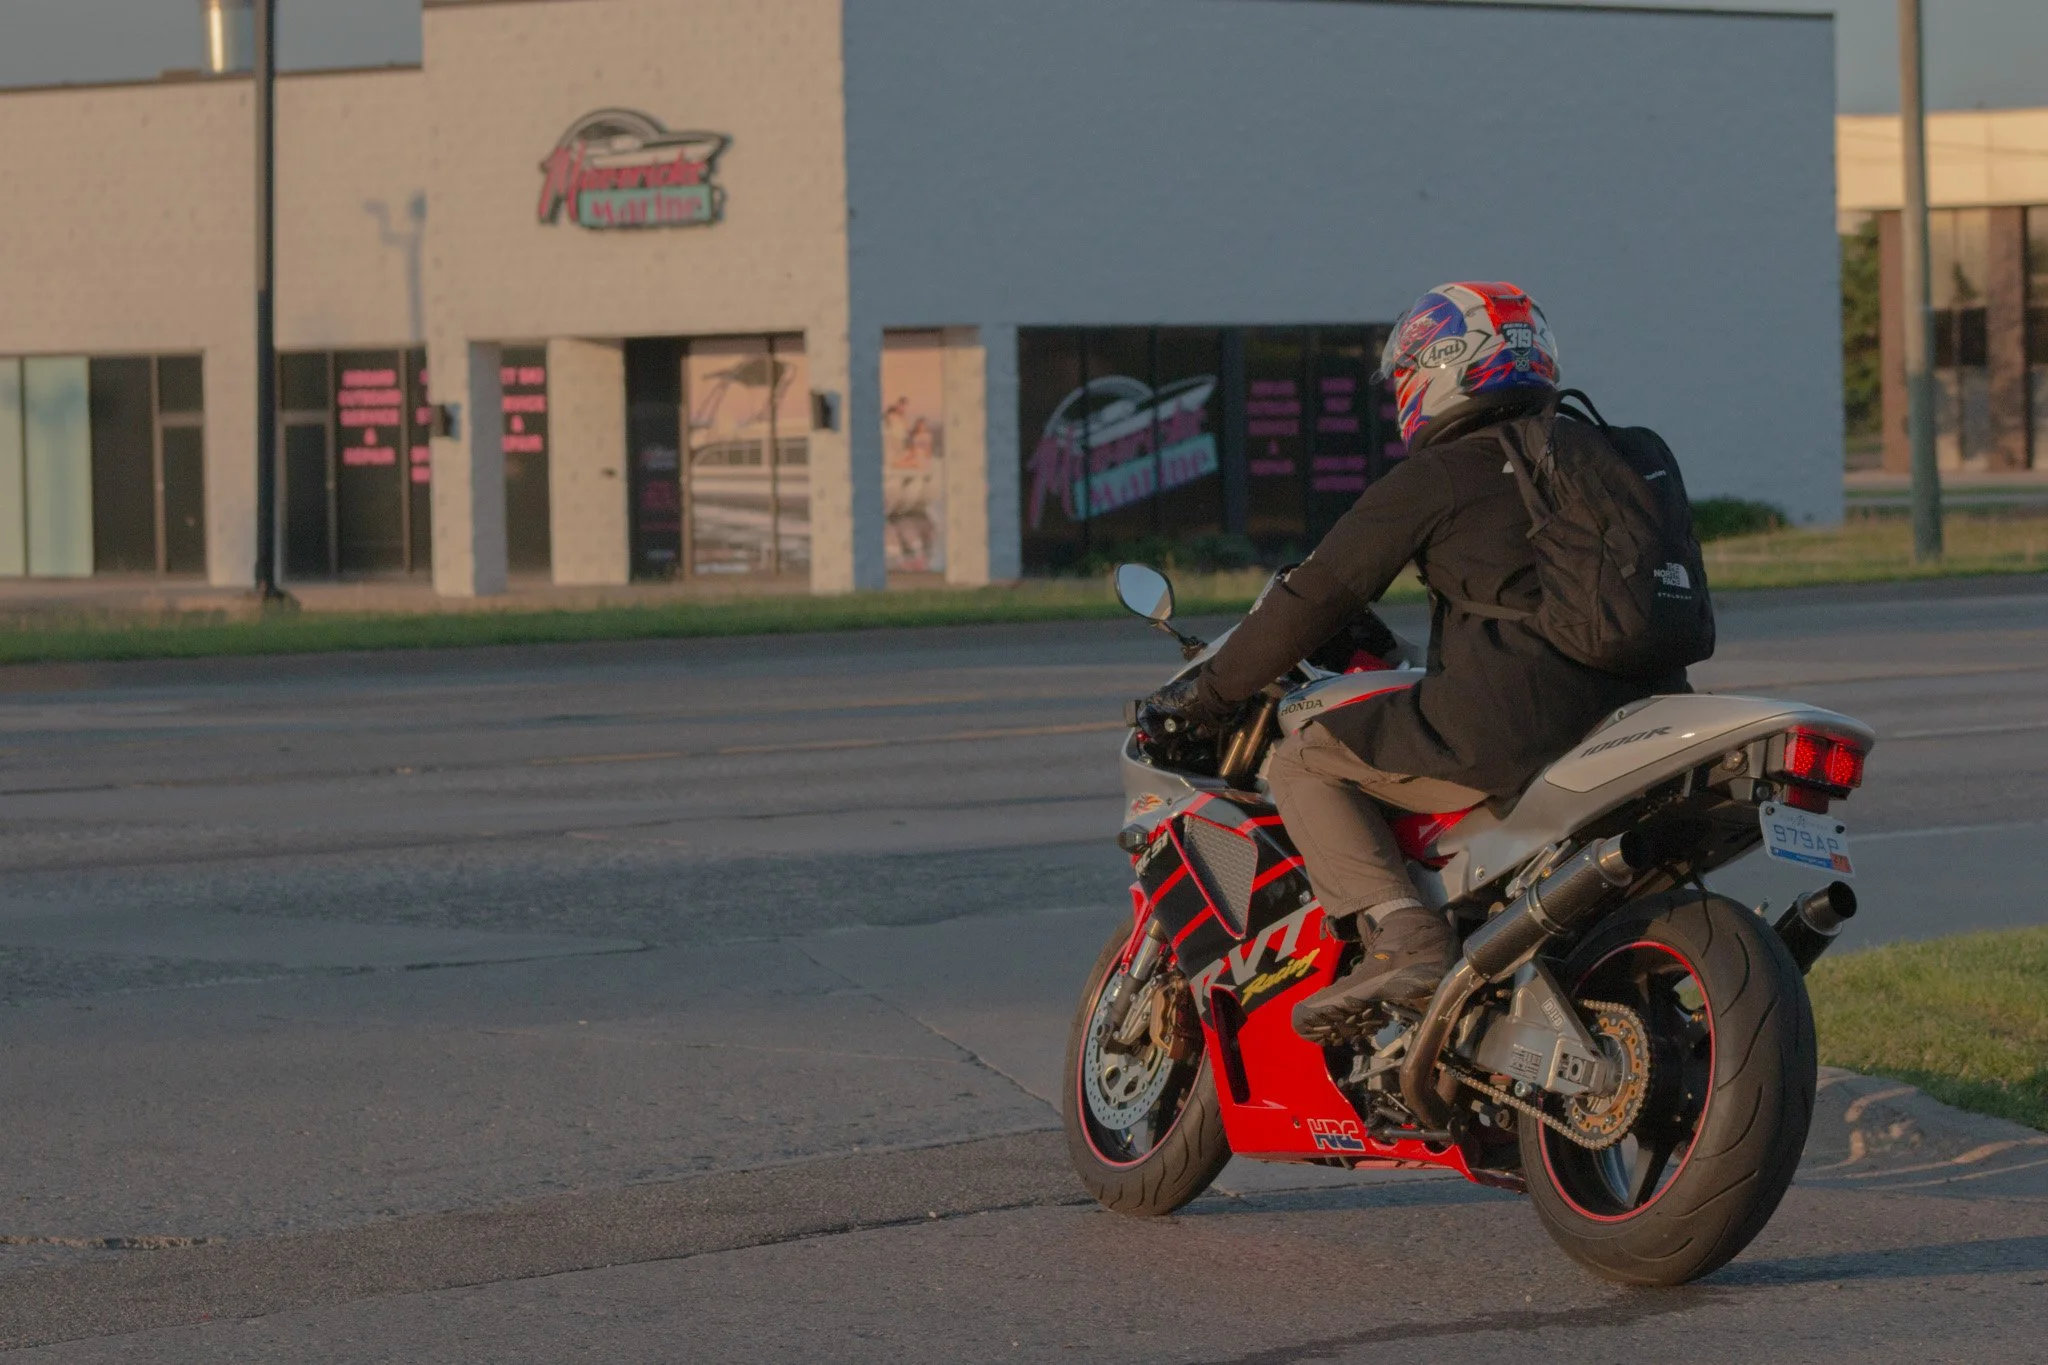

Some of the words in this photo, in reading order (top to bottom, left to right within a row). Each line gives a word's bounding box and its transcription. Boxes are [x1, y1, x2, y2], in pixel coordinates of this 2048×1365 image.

[1506, 328, 1533, 348] 319
[1426, 340, 1461, 363] Arai
[1653, 568, 1681, 579] NORTH
[1665, 562, 1680, 571] THE
[1662, 577, 1681, 587] FACE
[1281, 698, 1324, 716] HONDA
[1241, 947, 1320, 1006] Racing
